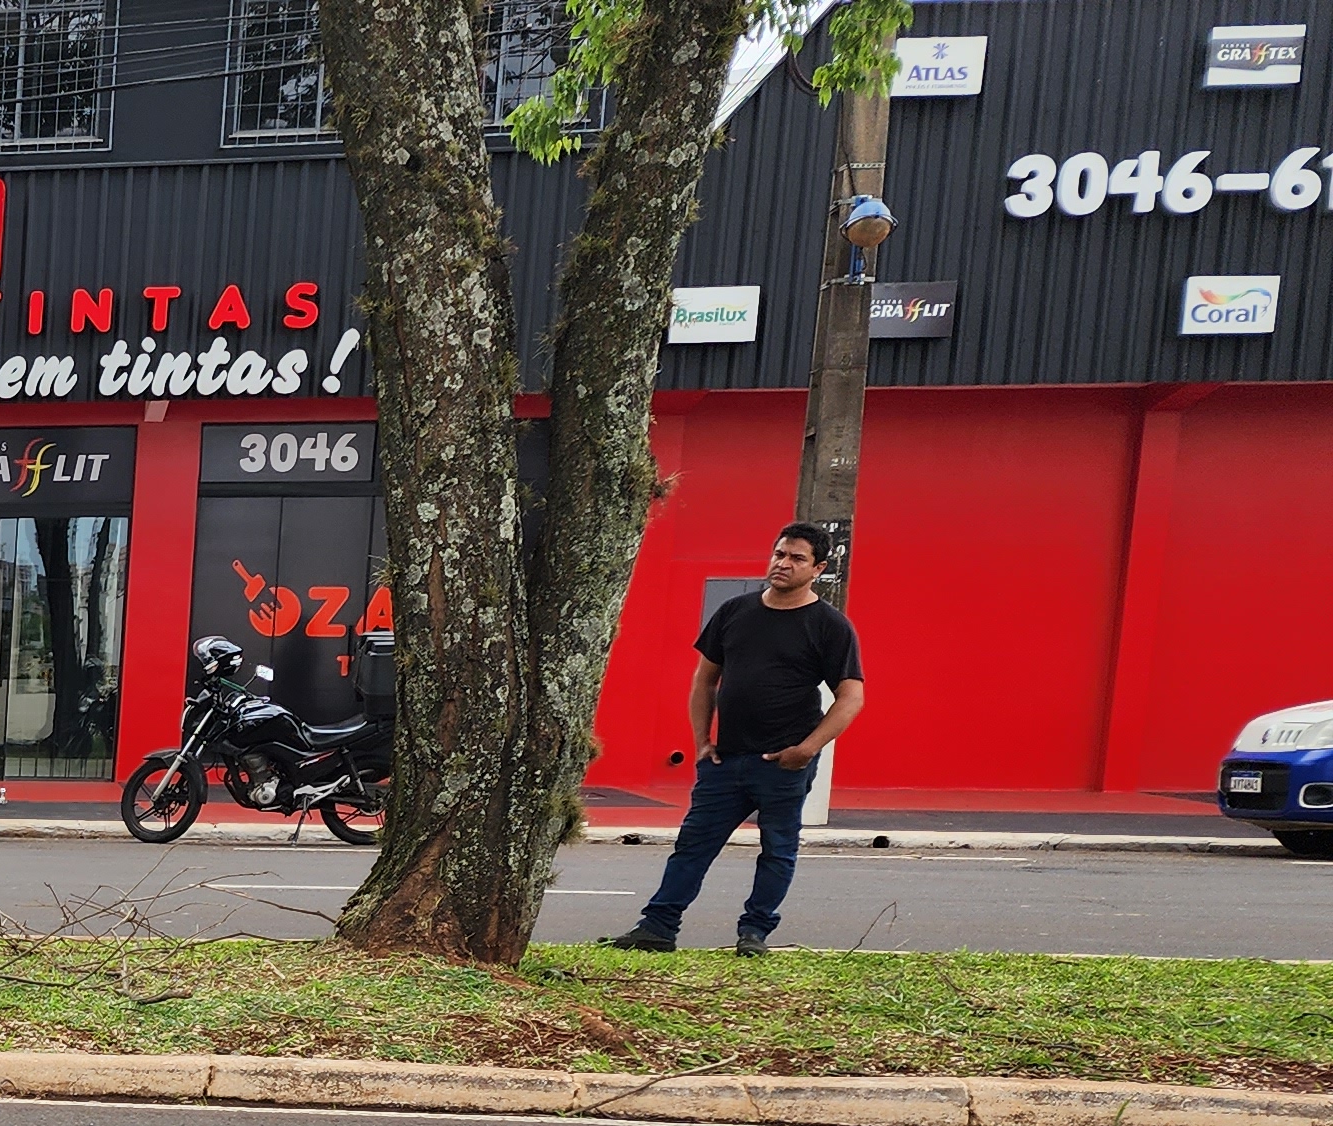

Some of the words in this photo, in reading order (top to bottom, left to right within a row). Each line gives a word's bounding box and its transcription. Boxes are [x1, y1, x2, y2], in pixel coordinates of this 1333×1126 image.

[907, 64, 968, 81] ATLAS
[1191, 304, 1257, 323] Coral
[239, 432, 359, 472] 3046
